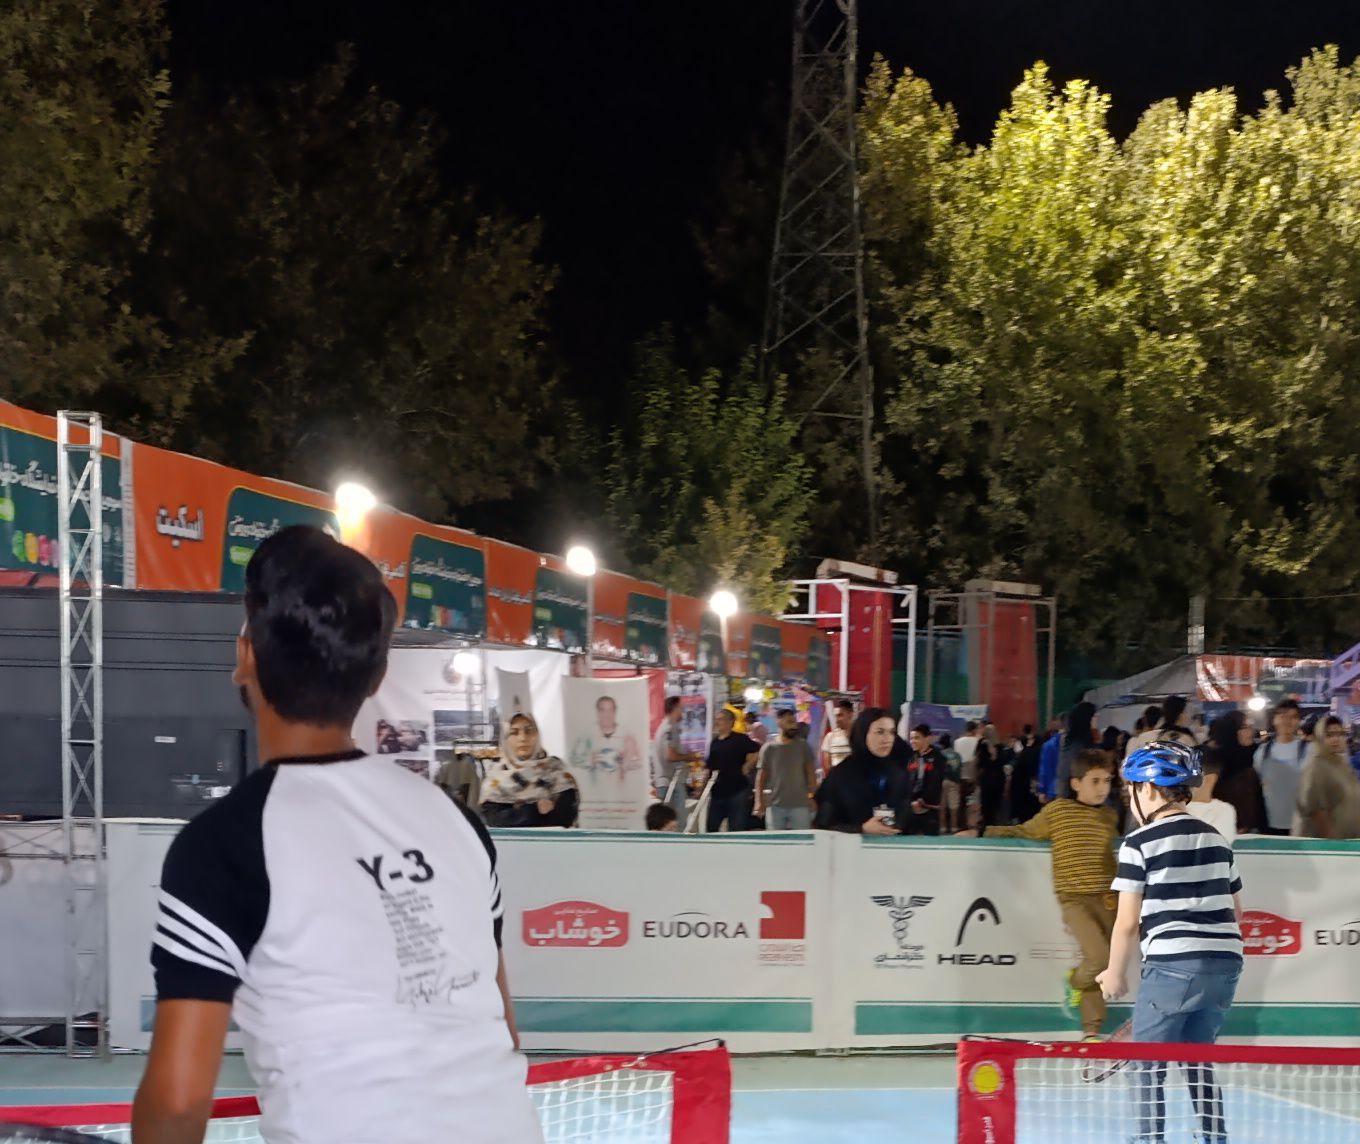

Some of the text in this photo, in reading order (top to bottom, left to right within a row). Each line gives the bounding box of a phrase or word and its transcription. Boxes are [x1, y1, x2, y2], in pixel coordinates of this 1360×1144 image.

[156, 505, 205, 547] اسکیت
[356, 849, 435, 892] Y-3
[529, 917, 621, 946] خوشاب
[643, 920, 750, 939] EUDORA
[1242, 926, 1295, 954] خوش
[937, 953, 1017, 966] HEAD
